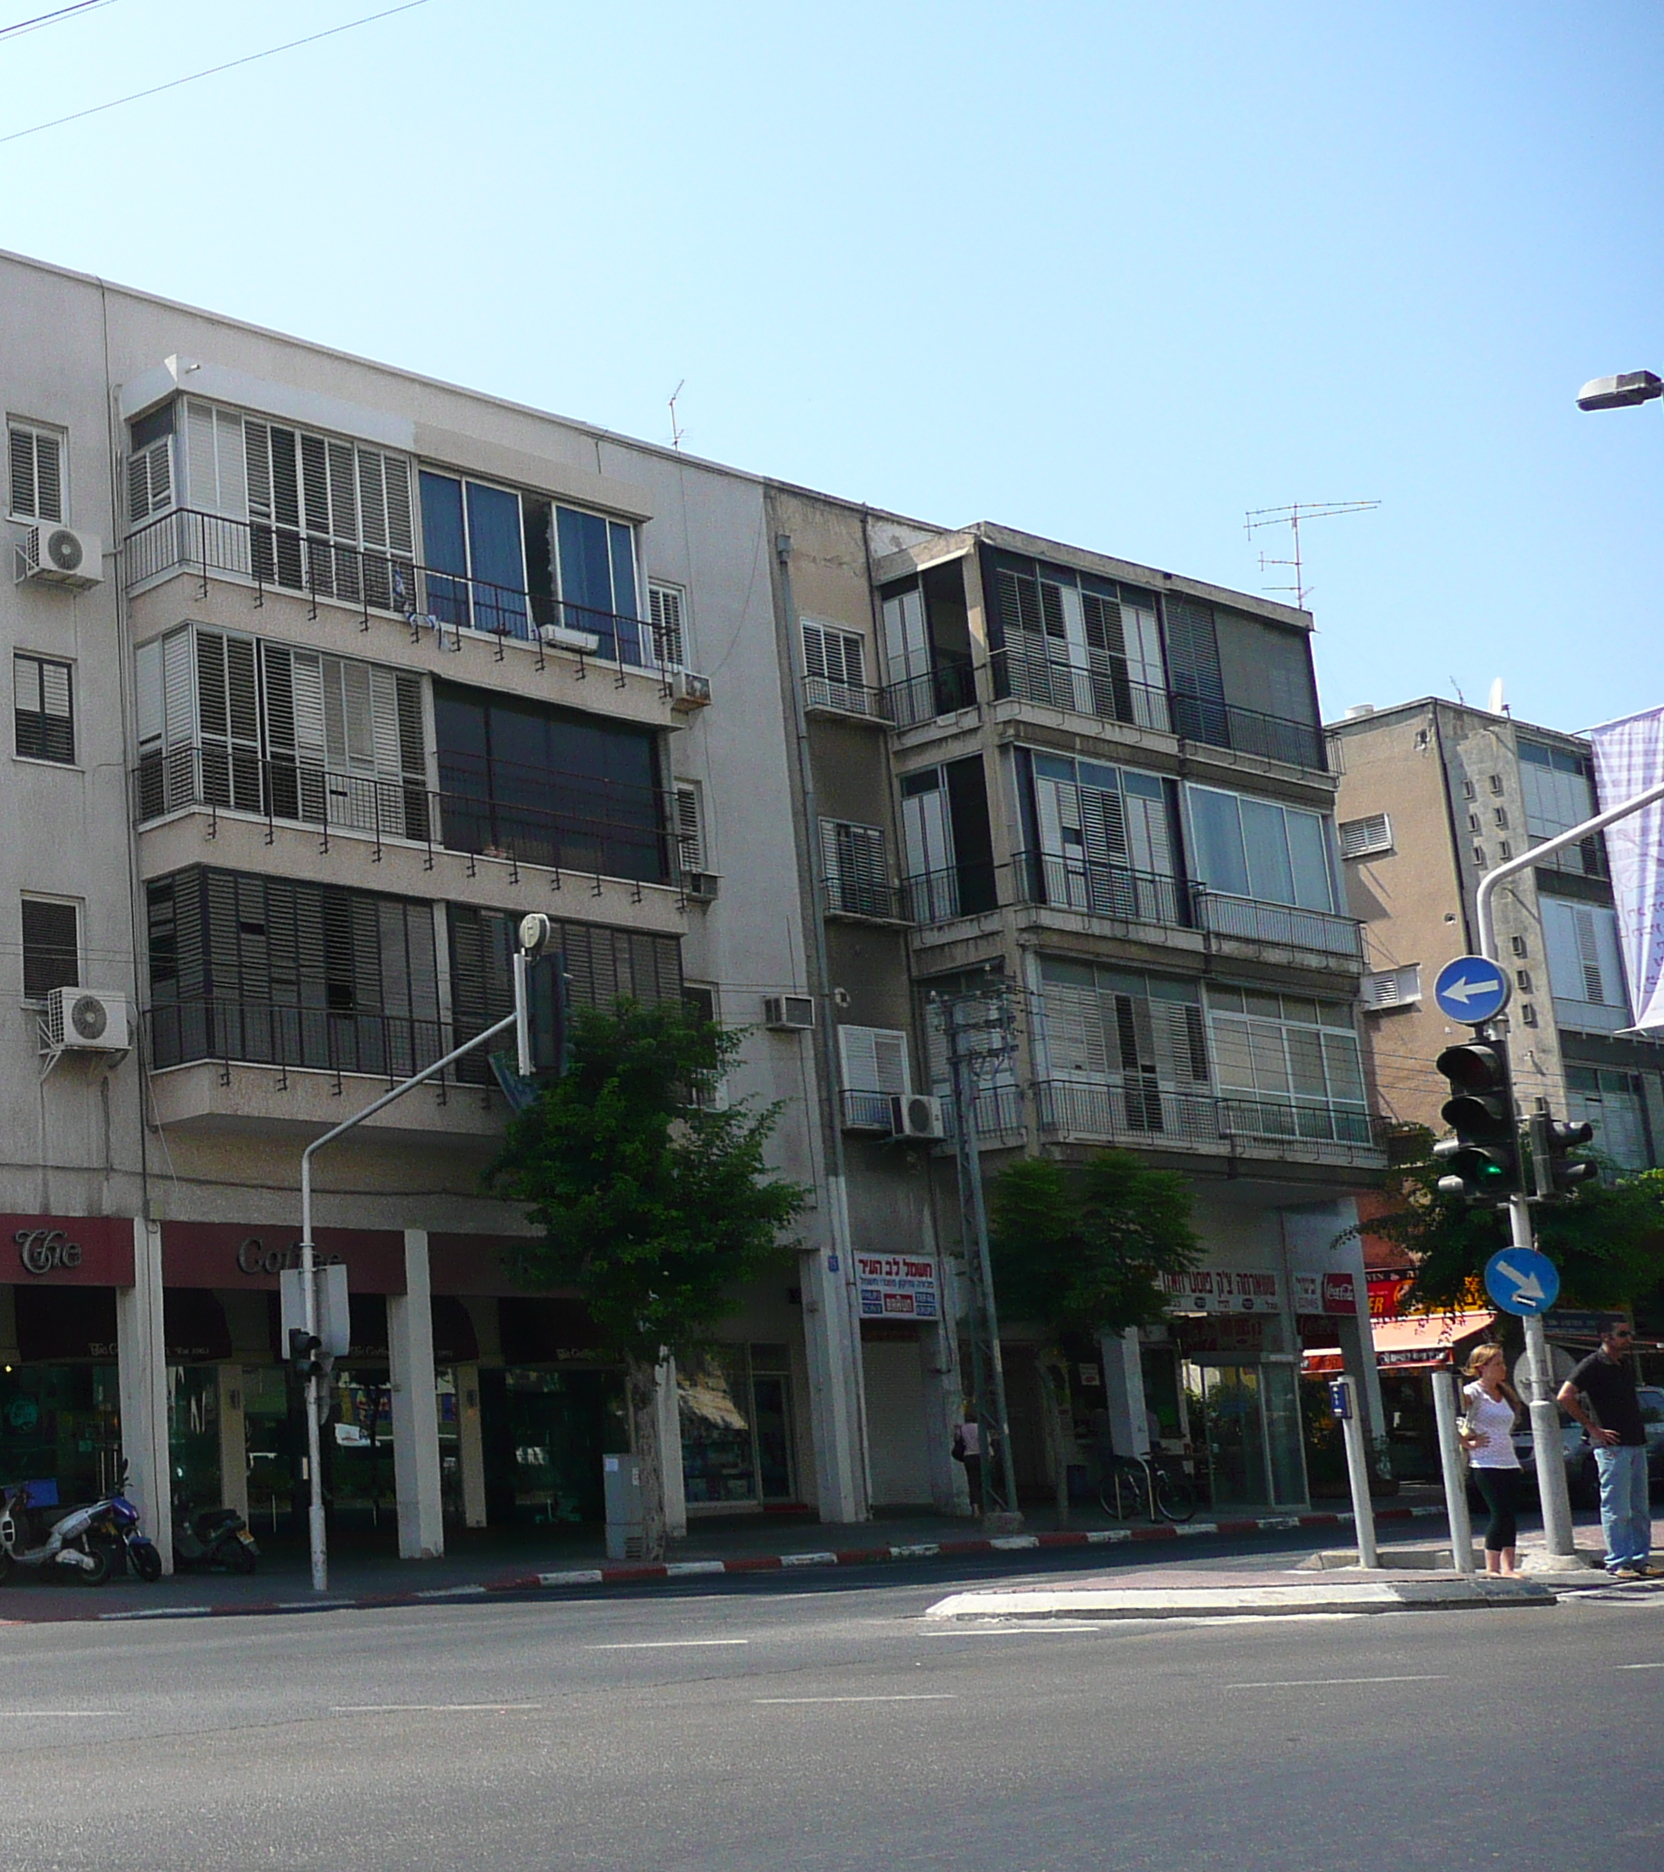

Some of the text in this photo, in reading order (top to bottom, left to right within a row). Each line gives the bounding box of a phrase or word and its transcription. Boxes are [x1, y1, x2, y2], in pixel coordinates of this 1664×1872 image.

[15, 1229, 82, 1274] The
[858, 1259, 883, 1275] העיר
[885, 1257, 900, 1276] לב
[903, 1258, 932, 1279] חשמל
